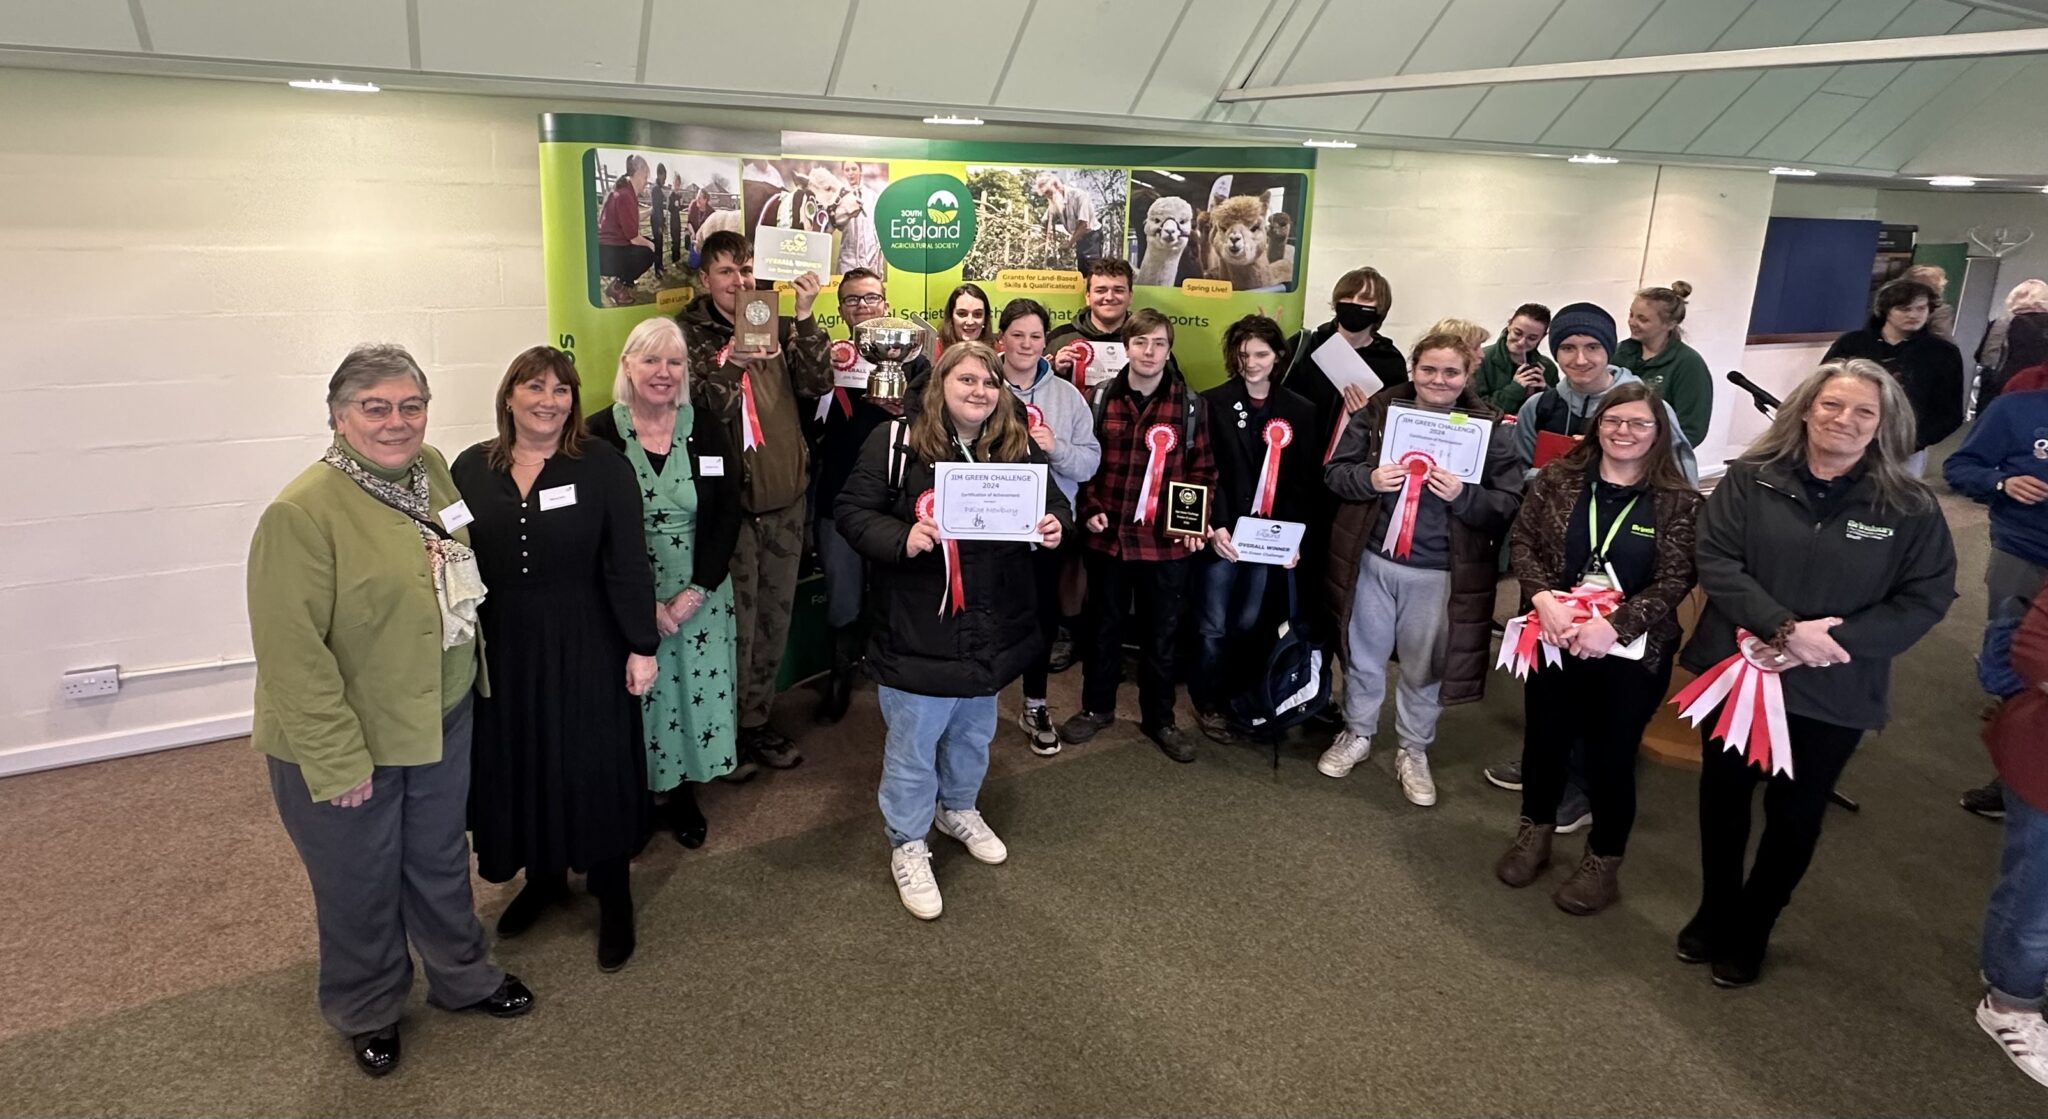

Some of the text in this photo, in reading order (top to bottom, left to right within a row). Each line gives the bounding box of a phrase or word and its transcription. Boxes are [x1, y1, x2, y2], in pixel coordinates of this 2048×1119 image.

[901, 209, 922, 217] SOUTH
[891, 219, 960, 241] England
[1029, 282, 1076, 290] Qualifications
[1187, 284, 1210, 293] Spring
[900, 307, 945, 320] Societ
[1048, 308, 1073, 320] hat
[1169, 315, 1209, 327] ports
[1415, 419, 1437, 427] GREEN
[1437, 422, 1476, 434] CHALLENGE
[1429, 428, 1446, 436] 2024
[1238, 542, 1265, 550] OVERALL
